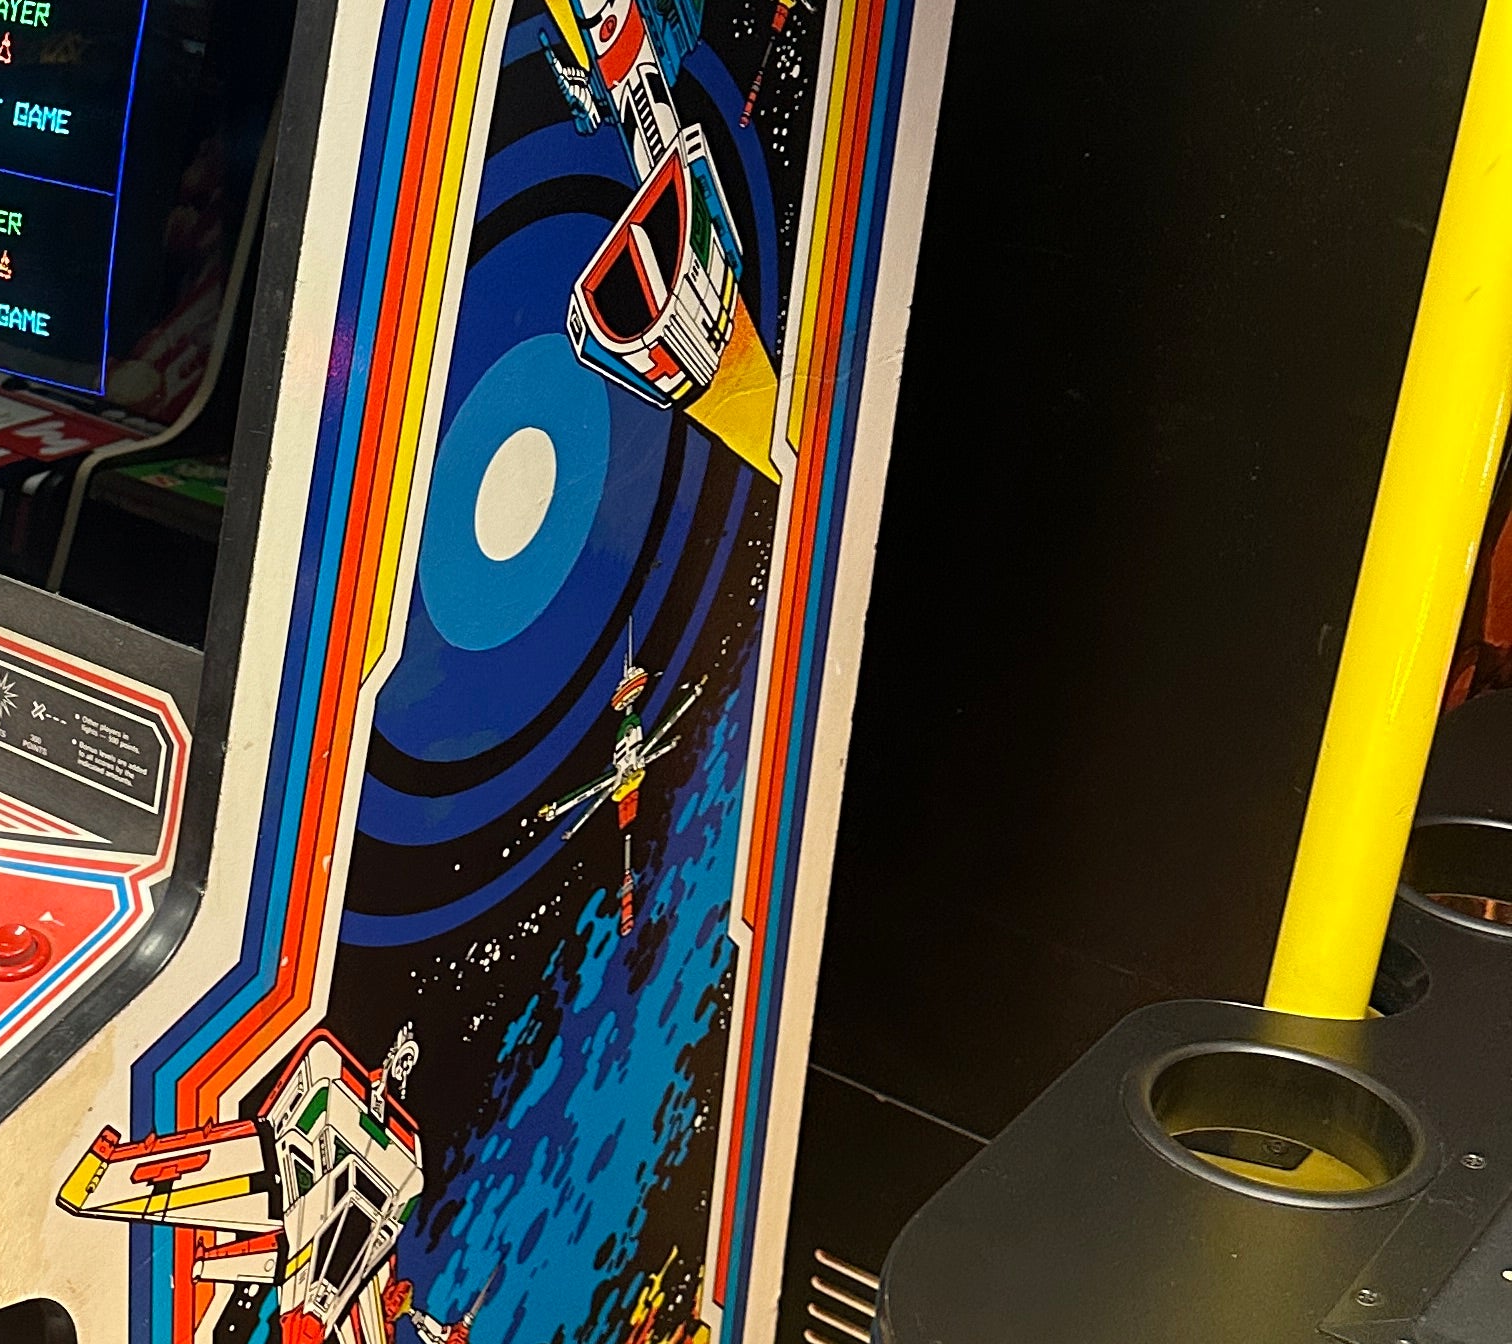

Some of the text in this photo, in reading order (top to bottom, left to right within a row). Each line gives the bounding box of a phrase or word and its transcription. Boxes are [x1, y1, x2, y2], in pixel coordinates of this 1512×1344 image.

[12, 101, 72, 135] GAME
[82, 715, 129, 740] Other players in
[22, 740, 48, 756] POINTS
[78, 741, 97, 755] Bonus
[117, 757, 127, 767] are
[127, 761, 147, 776] added
[77, 757, 104, 774] indicated
[78, 749, 85, 758] to
[94, 756, 114, 770] scores
[115, 765, 123, 775] by
[124, 769, 134, 779] the
